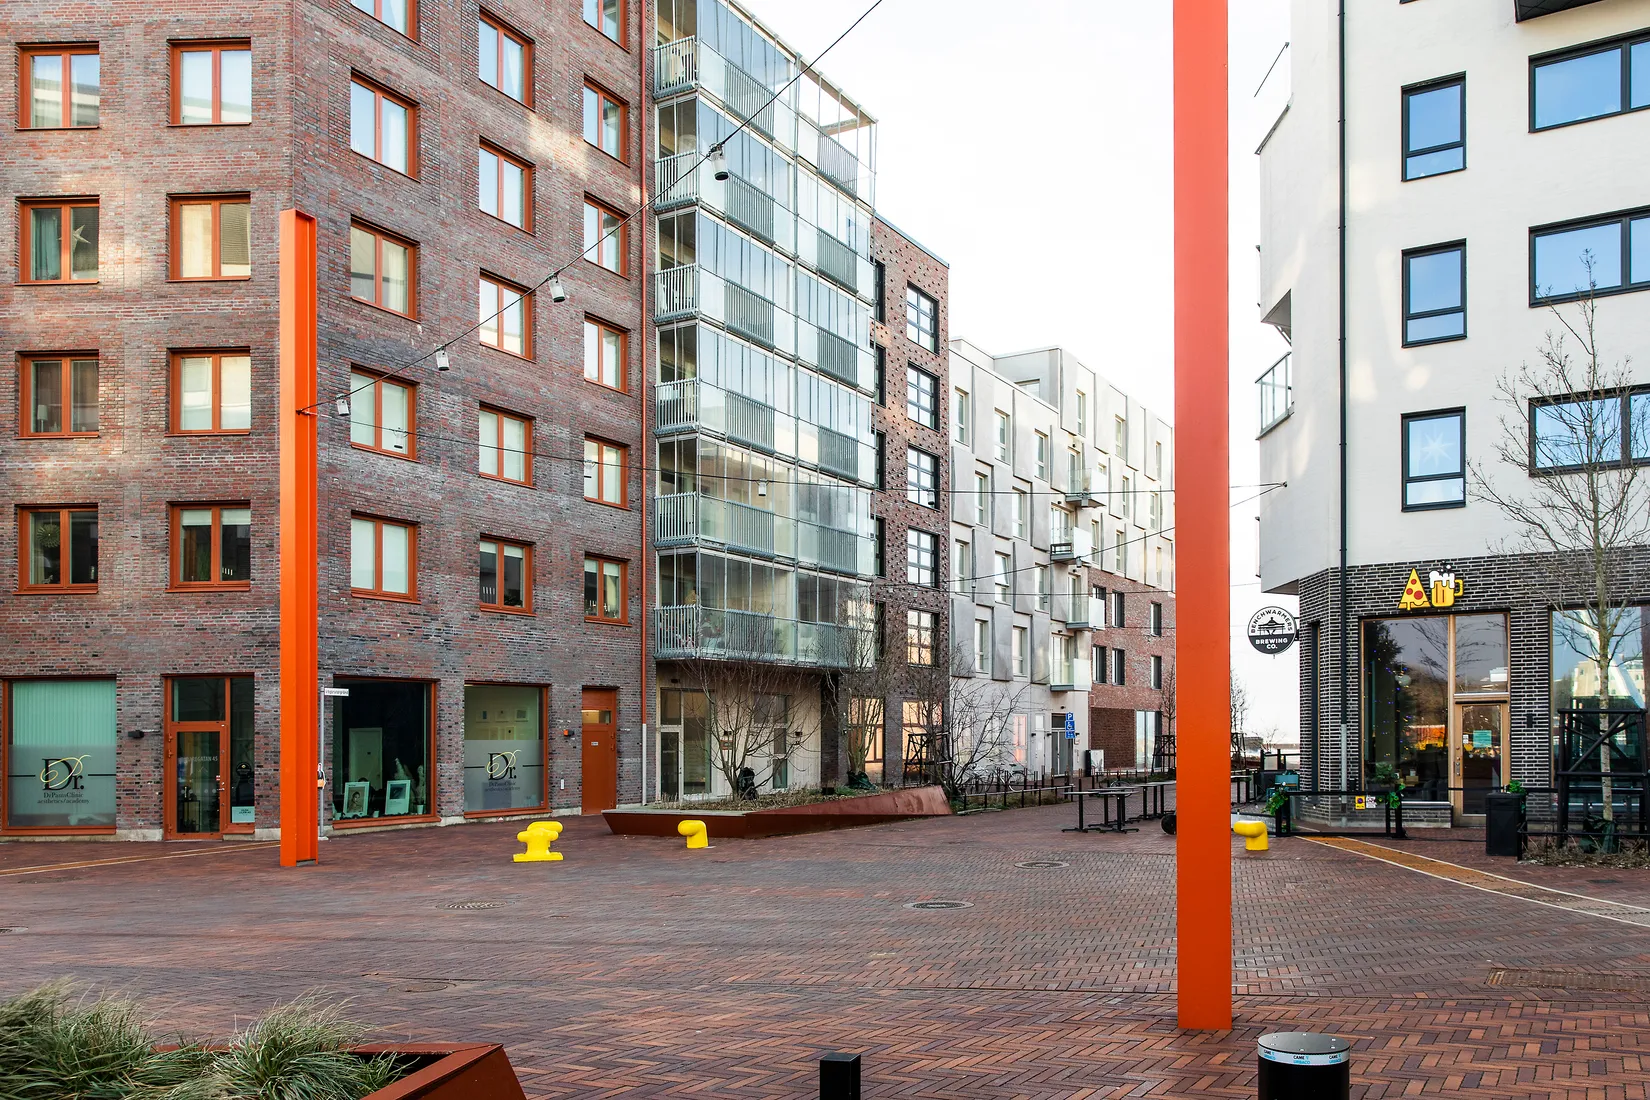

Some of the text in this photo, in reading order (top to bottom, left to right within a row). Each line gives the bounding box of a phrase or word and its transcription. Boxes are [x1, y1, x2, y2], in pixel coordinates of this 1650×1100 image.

[1251, 610, 1292, 633] BENCHWARMERS
[41, 757, 84, 790] Dr.
[487, 752, 517, 780] Dr.
